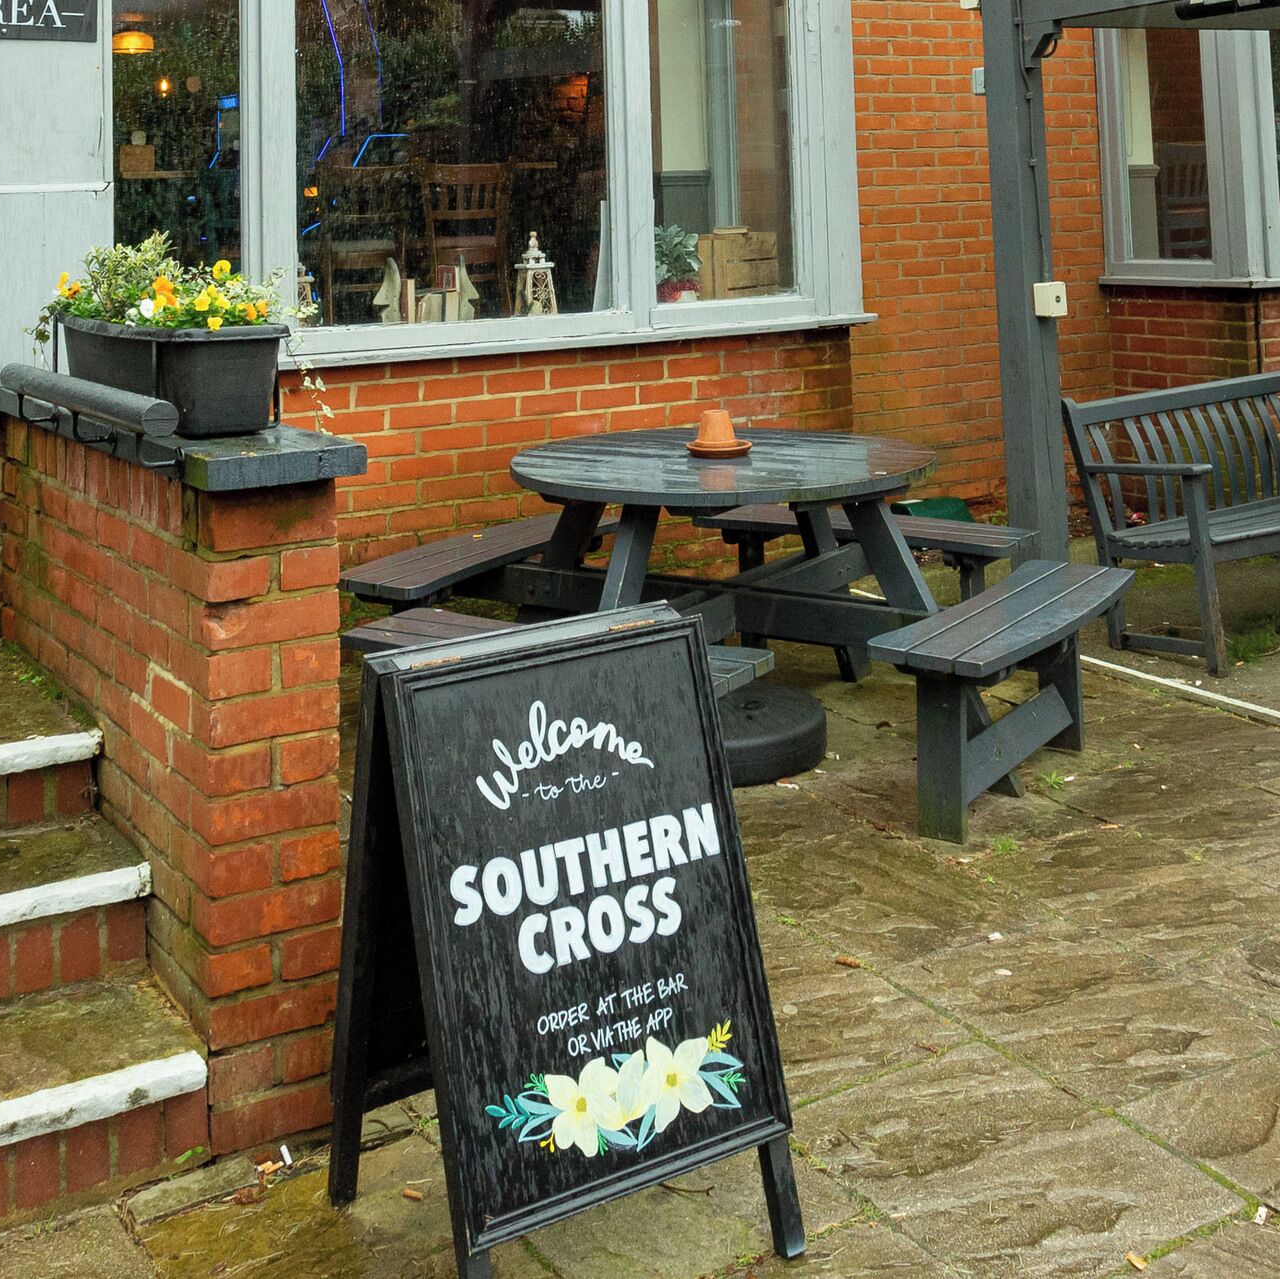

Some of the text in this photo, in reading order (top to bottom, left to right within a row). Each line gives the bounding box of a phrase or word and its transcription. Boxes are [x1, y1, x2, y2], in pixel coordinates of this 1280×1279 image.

[476, 700, 654, 810] Welcome
[534, 773, 607, 800] to the
[450, 802, 720, 926] SOUTHERN
[518, 877, 682, 974] CROSS
[537, 973, 688, 1035] ORDER AT THE BAR
[568, 1007, 673, 1056] OR VIA THE APP
